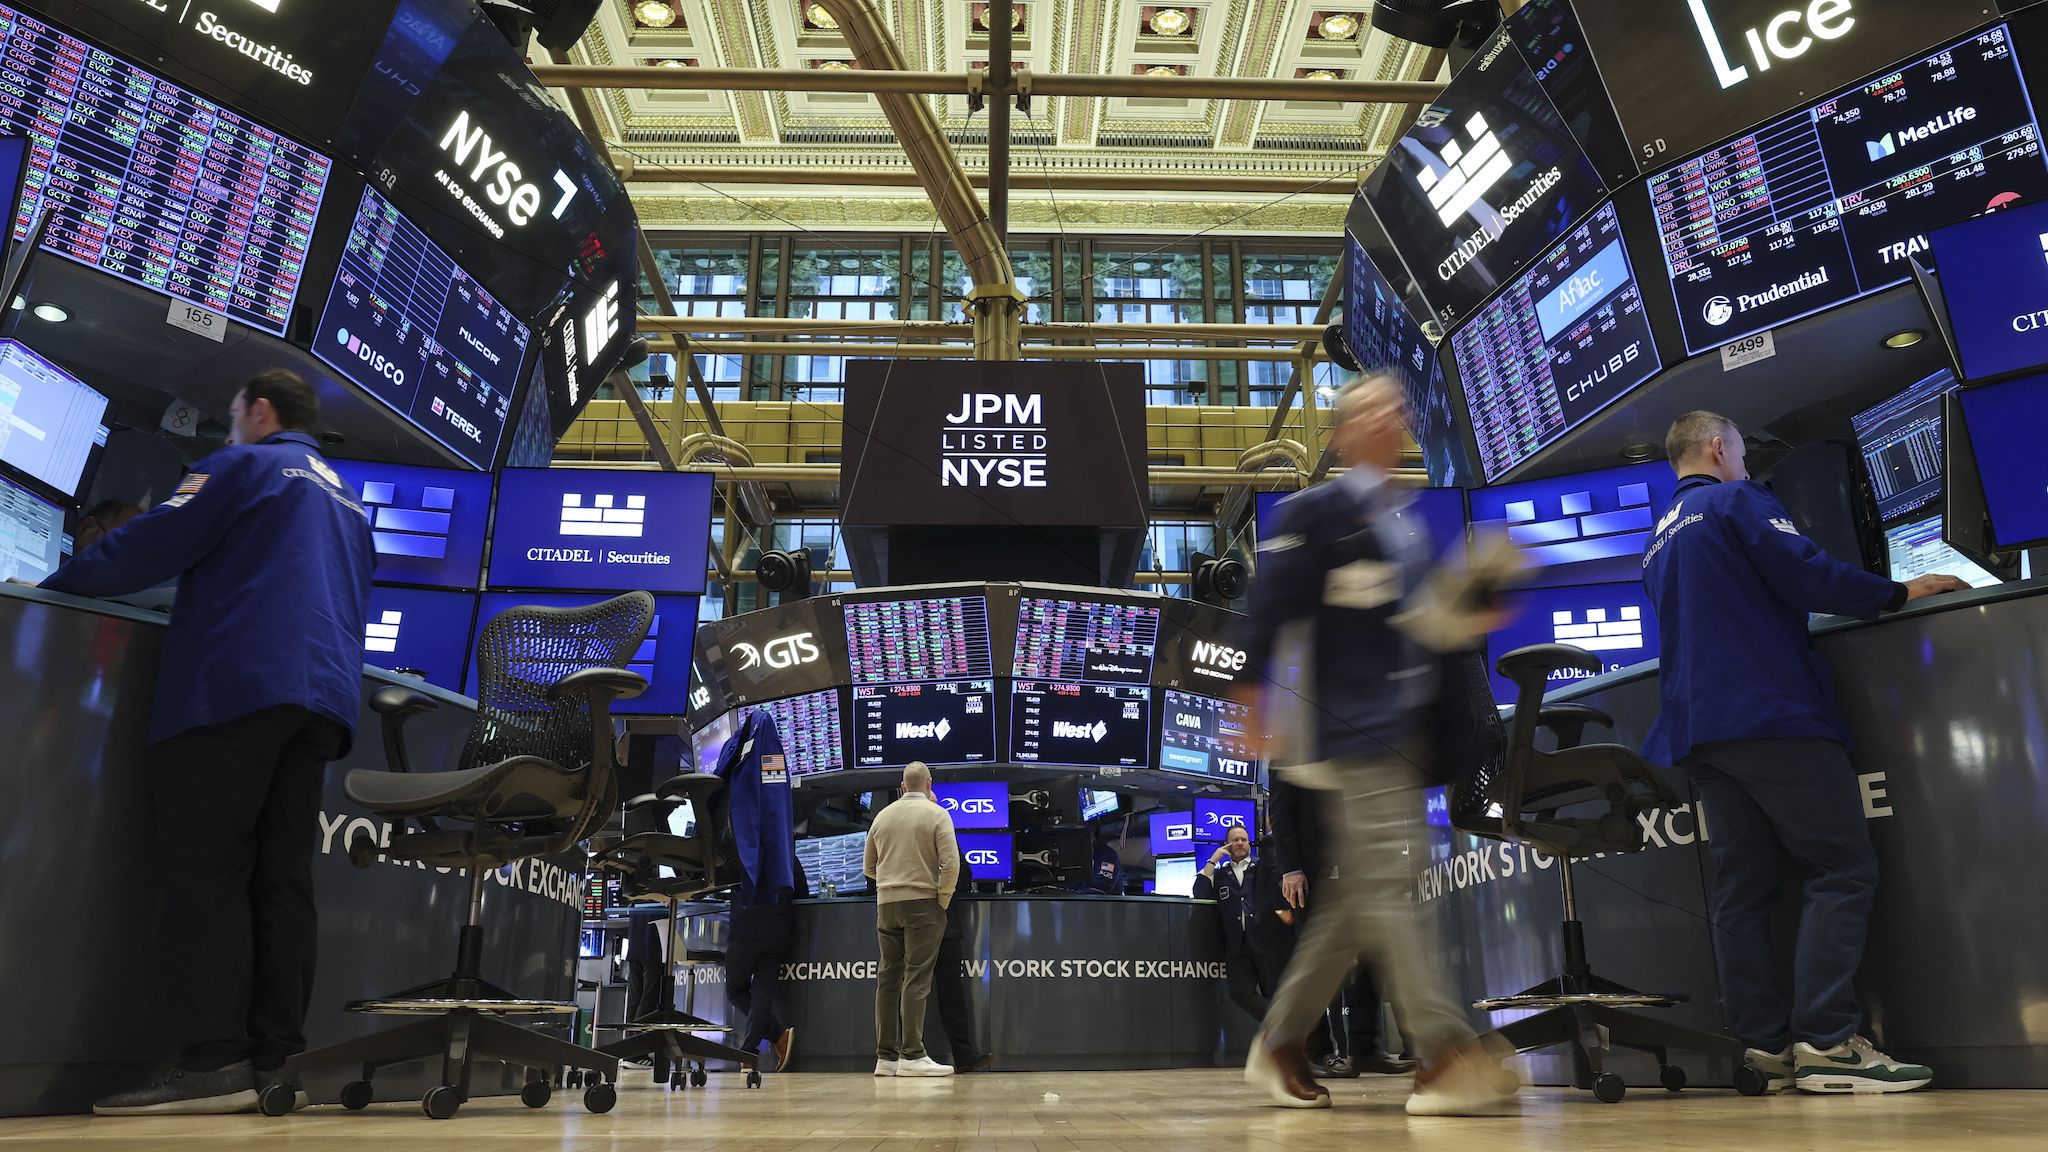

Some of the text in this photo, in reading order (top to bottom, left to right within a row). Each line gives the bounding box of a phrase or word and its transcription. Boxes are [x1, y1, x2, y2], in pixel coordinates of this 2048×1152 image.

[20, 17, 46, 34] CBNA
[16, 27, 39, 43] CBT
[1977, 29, 2003, 46] 78.68
[12, 38, 35, 54] CBZ
[195, 11, 314, 86] Securities
[1981, 45, 2008, 62] 78.31
[9, 49, 36, 66] CHGG
[91, 50, 114, 66] ERO
[1927, 51, 1952, 68] 78.53
[5, 60, 30, 76] COPL
[88, 60, 113, 77] EVAC
[1930, 67, 1956, 83] 78.88
[158, 82, 179, 98] GNK
[1869, 72, 1903, 93] 78.5900
[155, 92, 179, 107] GROV
[1882, 88, 1907, 104] 78.70
[75, 102, 97, 118] EXK
[1817, 100, 1839, 115] MET
[71, 113, 87, 126] FN
[220, 110, 241, 125] MAIN
[1833, 107, 1860, 125] 74,350
[145, 121, 157, 133] HI
[217, 121, 239, 136] MATX
[1898, 105, 1977, 147] MetLife
[142, 133, 163, 147] HIPO
[214, 130, 234, 145] MSB
[2001, 126, 2033, 145] 280.69
[139, 143, 161, 157] HLLY
[278, 138, 299, 153] PEW
[2006, 142, 2038, 161] 279.69
[57, 156, 78, 170] FSS
[136, 153, 157, 167] HPP
[208, 150, 230, 165] NOTE
[1703, 151, 1721, 164] USB
[1705, 158, 1729, 173] UWMC
[54, 166, 80, 182] FUBO
[202, 171, 222, 184] NUE
[434, 169, 450, 186] AN
[1651, 173, 1670, 186] RYAN
[1707, 170, 1728, 182] VOYA
[1891, 166, 1930, 188] 280.6300
[1954, 162, 1985, 181] 281.48
[51, 177, 76, 193] GATX
[1710, 178, 1732, 193] WCN
[1905, 181, 1934, 200] 281.29
[1713, 191, 1730, 202] WM
[1841, 192, 1864, 207] TRV
[193, 201, 214, 216] ODC
[1658, 203, 1674, 214] SSB
[1715, 198, 1736, 212] WSO
[1859, 200, 1887, 216] 49,630
[117, 216, 140, 230] JOBY
[1437, 165, 1562, 281] CITADEL Securities
[1661, 212, 1676, 224] TFC
[113, 226, 134, 241] KEX
[1765, 220, 1791, 237] 116.90
[1812, 218, 1839, 235] 116.50
[110, 236, 134, 252] LAW
[181, 241, 196, 254] OR
[1667, 240, 1685, 253] UCB
[1716, 237, 1749, 256] 117.0750
[1768, 235, 1795, 251] 117.14
[106, 248, 128, 262] LXP
[1669, 249, 1689, 263] UNM
[1727, 252, 1752, 267] 117.14
[103, 259, 125, 274] LZM
[1673, 259, 1693, 273] PRU
[172, 273, 192, 287] PDS
[1687, 267, 1712, 283] 28,332
[1737, 265, 1829, 313] Prudential
[185, 307, 213, 326] 155
[458, 326, 501, 366] NUCOR
[1728, 336, 1764, 357] 2499
[358, 342, 405, 386] DISCO
[1566, 343, 1640, 402] CHUBB
[945, 393, 1042, 425] JPM
[942, 433, 1047, 450] LISTED
[941, 458, 1047, 487] NYSE
[1668, 512, 1704, 539] Securities
[526, 547, 671, 566] CITADEL Securities
[763, 632, 819, 669] GTS
[1547, 667, 1596, 680] ADEL
[858, 688, 876, 696] WST
[1017, 682, 1035, 690] WST
[1175, 712, 1202, 730] CAVA
[896, 721, 935, 740] West
[1053, 720, 1092, 739] West
[1217, 758, 1250, 777] YETI
[1417, 864, 1443, 904] NEW
[1445, 844, 1497, 892] YORK
[693, 967, 721, 985] YORK
[993, 960, 1056, 978] YORK
[1060, 960, 1131, 978] STOCK
[1135, 960, 1228, 979] EXCHANGE
